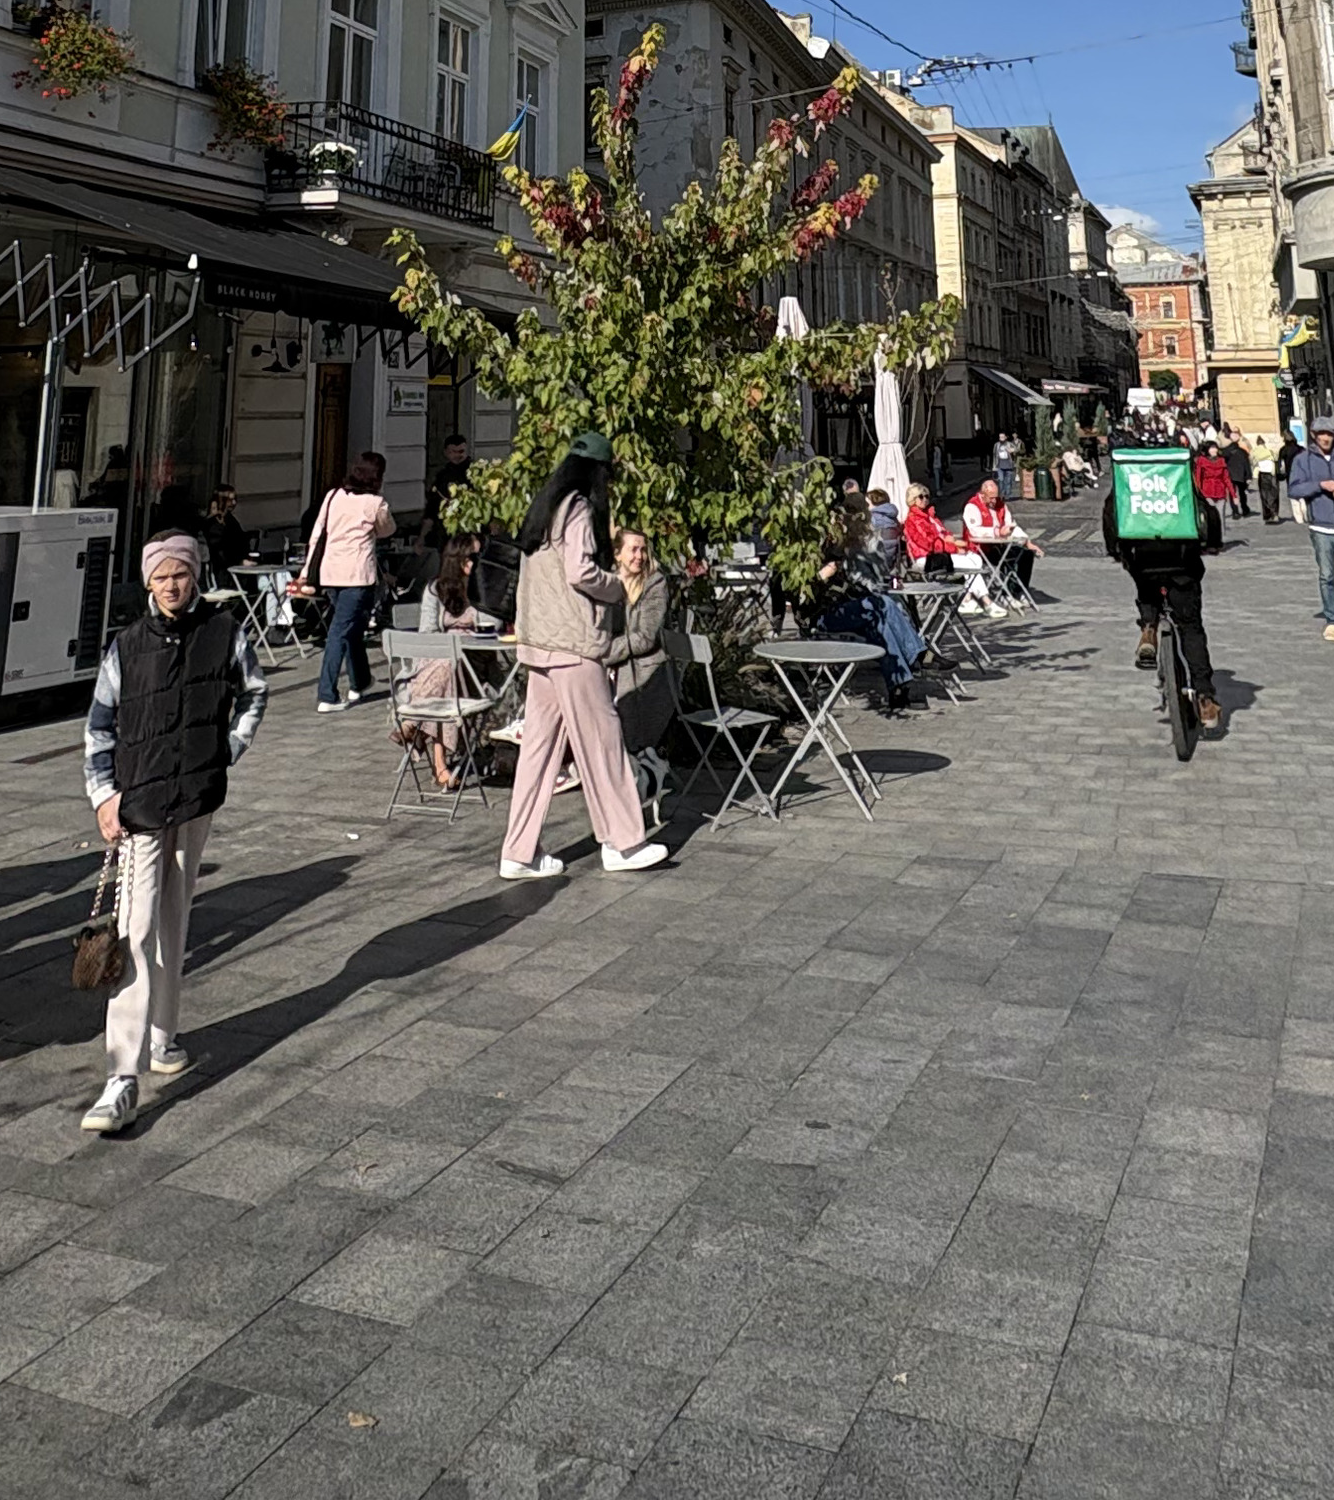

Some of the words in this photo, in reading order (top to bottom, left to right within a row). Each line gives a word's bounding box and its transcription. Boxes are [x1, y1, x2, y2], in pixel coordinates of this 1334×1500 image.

[217, 284, 246, 297] BLACK
[1128, 473, 1167, 494] Bolt
[1130, 494, 1179, 515] Food
